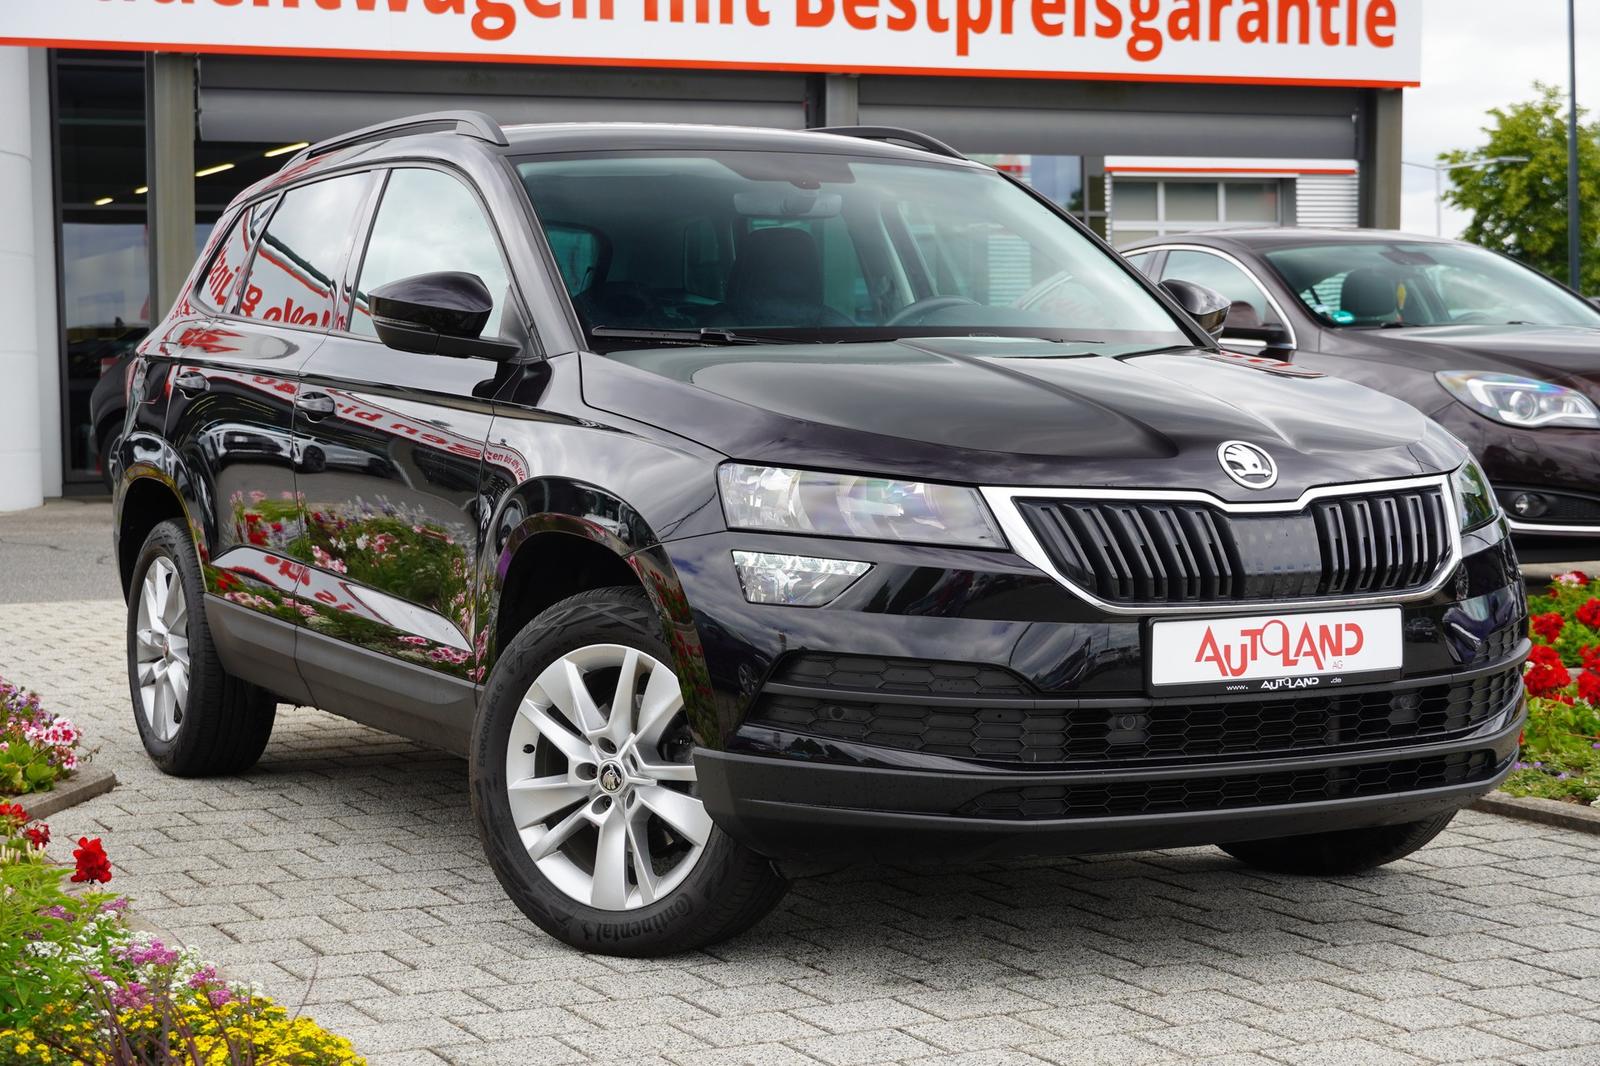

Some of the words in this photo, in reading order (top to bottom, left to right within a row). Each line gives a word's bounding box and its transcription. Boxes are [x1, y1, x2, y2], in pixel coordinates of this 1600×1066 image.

[1195, 619, 1364, 677] AUTOLAND
[1331, 659, 1345, 670] AG
[1260, 677, 1320, 690] AUTOLAND
